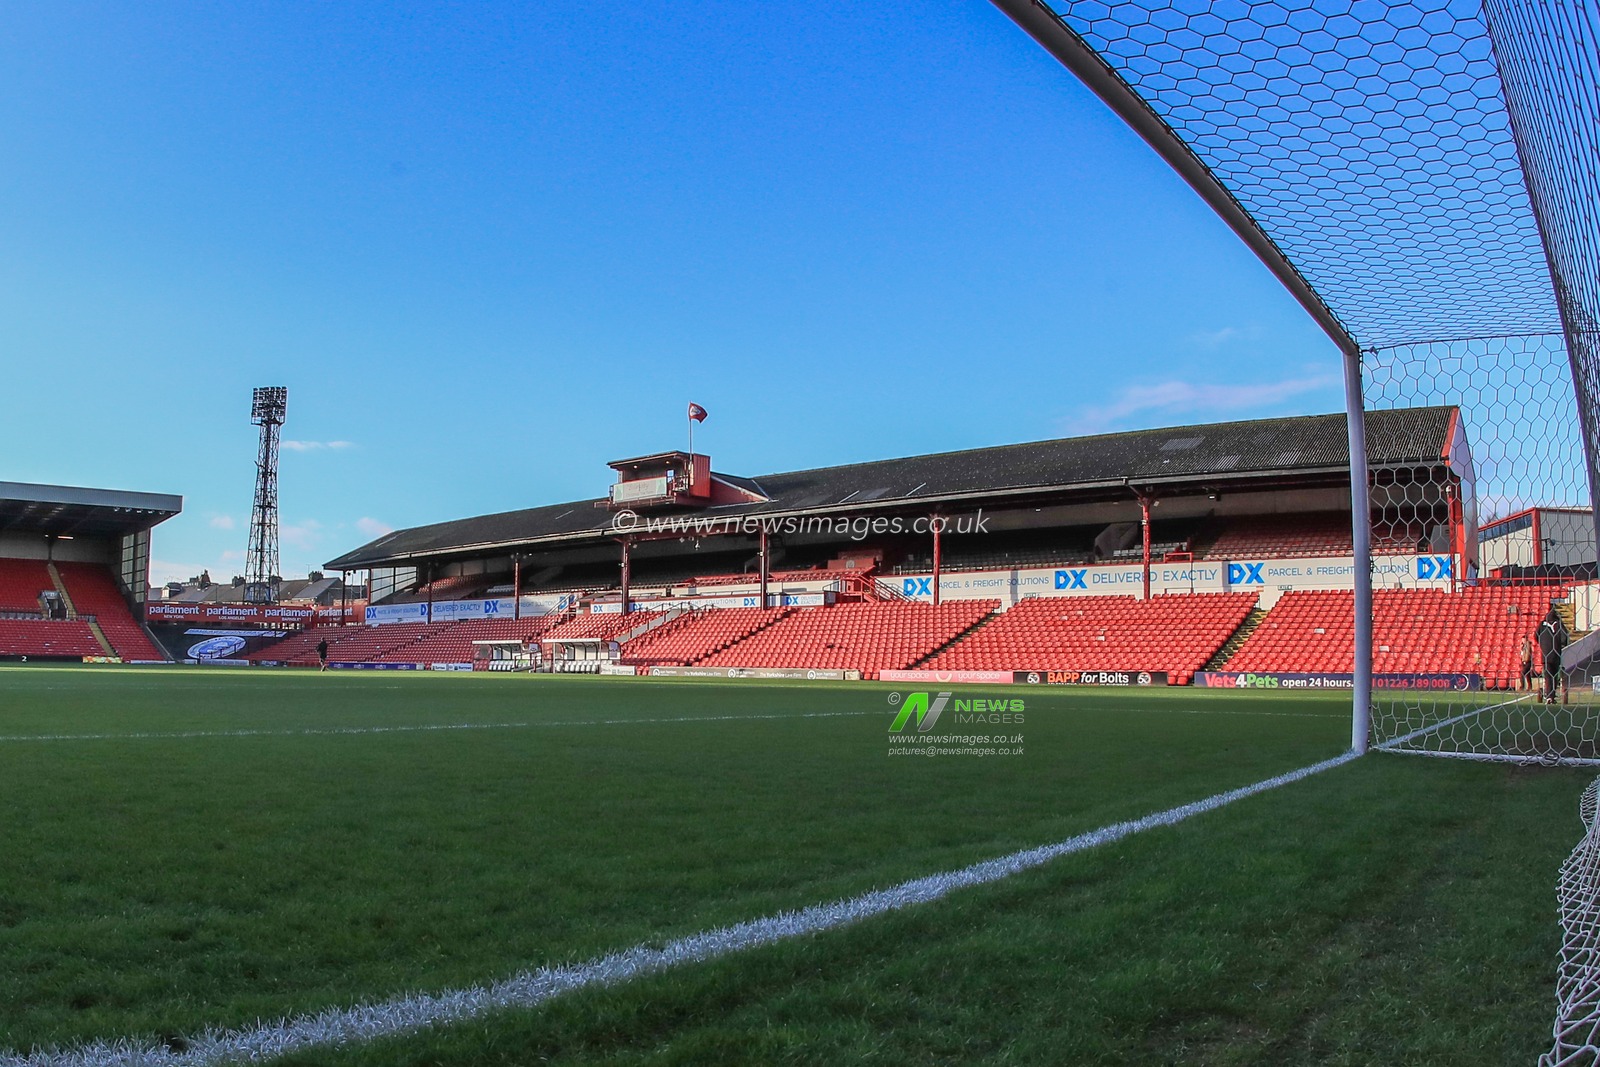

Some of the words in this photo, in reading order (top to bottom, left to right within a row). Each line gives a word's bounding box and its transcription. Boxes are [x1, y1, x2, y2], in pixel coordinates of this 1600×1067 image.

[1228, 562, 1265, 584] DX
[1268, 567, 1302, 576] PARCEL
[1306, 567, 1312, 576] &
[1316, 566, 1354, 575] FREIGHT
[1417, 557, 1452, 579] DX
[1054, 569, 1088, 590] DX
[1163, 569, 1217, 582] EXACTLY
[903, 577, 932, 596] DX
[937, 581, 962, 589] ARCEL
[973, 579, 1003, 588] FREIGHT
[1007, 577, 1050, 586] SOLUTIONS
[484, 600, 499, 613] DX
[593, 604, 603, 612] DX
[743, 598, 756, 606] DX
[149, 605, 200, 615] parliament
[206, 606, 258, 616] parliament
[265, 608, 313, 617] parliament
[366, 607, 377, 619] DX
[434, 605, 458, 613] DELIVERED
[460, 604, 481, 612] EXACTLY
[1047, 671, 1080, 683] BAPP
[1080, 671, 1098, 683] for
[1099, 672, 1129, 683] Bolts
[1204, 673, 1279, 688] Vets4Pets
[1282, 678, 1307, 688] open
[1308, 677, 1321, 687] 24
[1323, 677, 1354, 687] hours.
